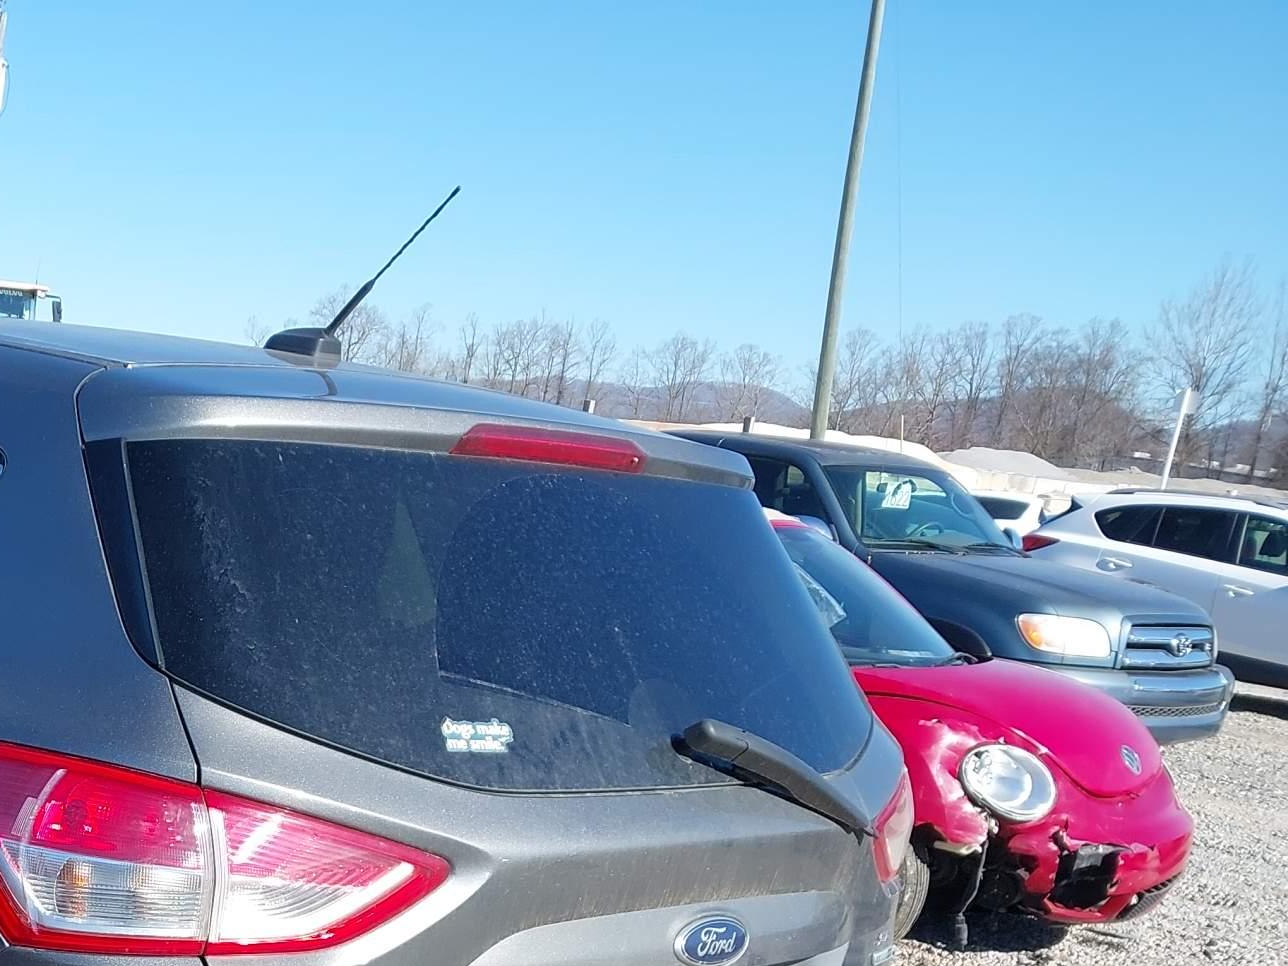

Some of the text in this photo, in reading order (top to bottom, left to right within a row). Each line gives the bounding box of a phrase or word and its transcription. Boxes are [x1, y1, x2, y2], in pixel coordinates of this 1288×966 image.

[442, 718, 511, 740] Dogs make
[447, 739, 469, 752] me
[697, 926, 737, 957] Ford
